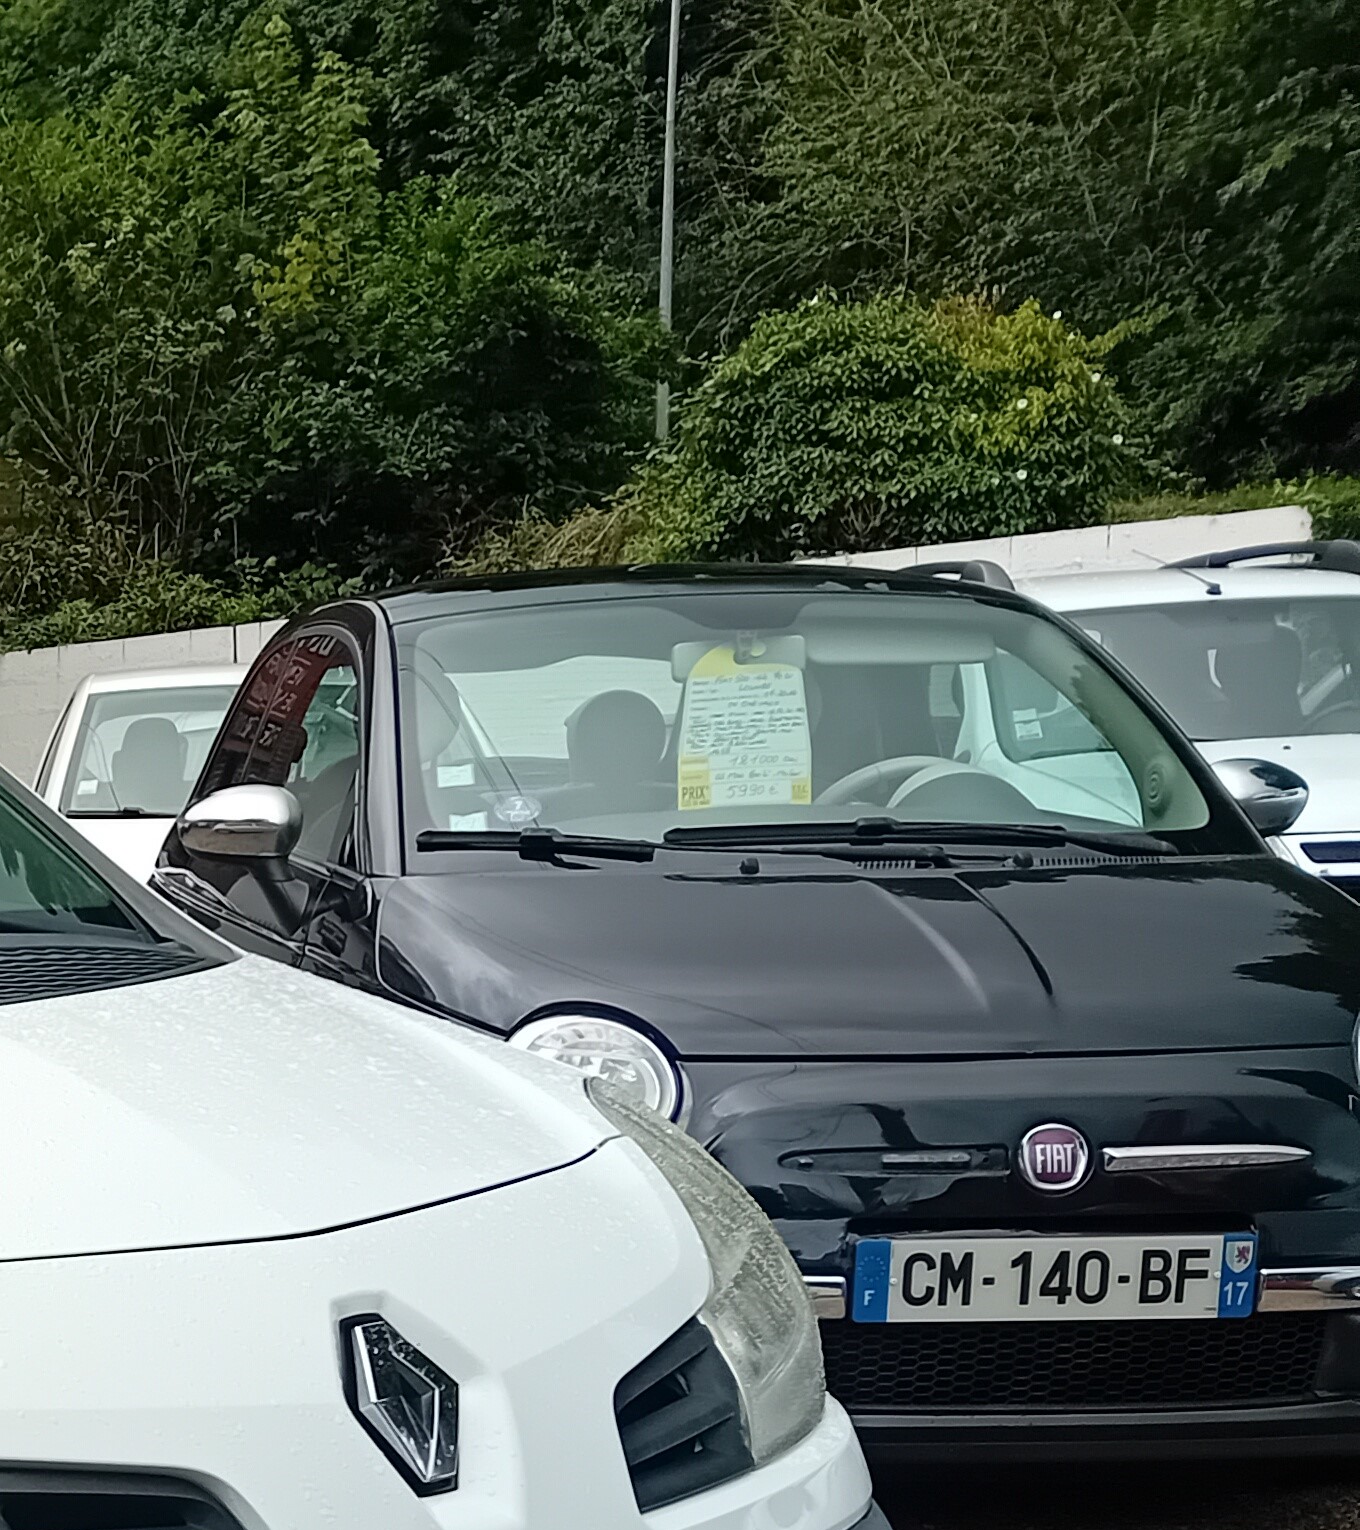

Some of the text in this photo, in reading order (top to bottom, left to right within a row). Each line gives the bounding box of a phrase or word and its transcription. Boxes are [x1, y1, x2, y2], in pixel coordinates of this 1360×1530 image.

[726, 783, 765, 800] 5990
[1035, 1143, 1075, 1174] FIAT
[862, 1289, 876, 1307] F
[1222, 1280, 1248, 1308] 17
